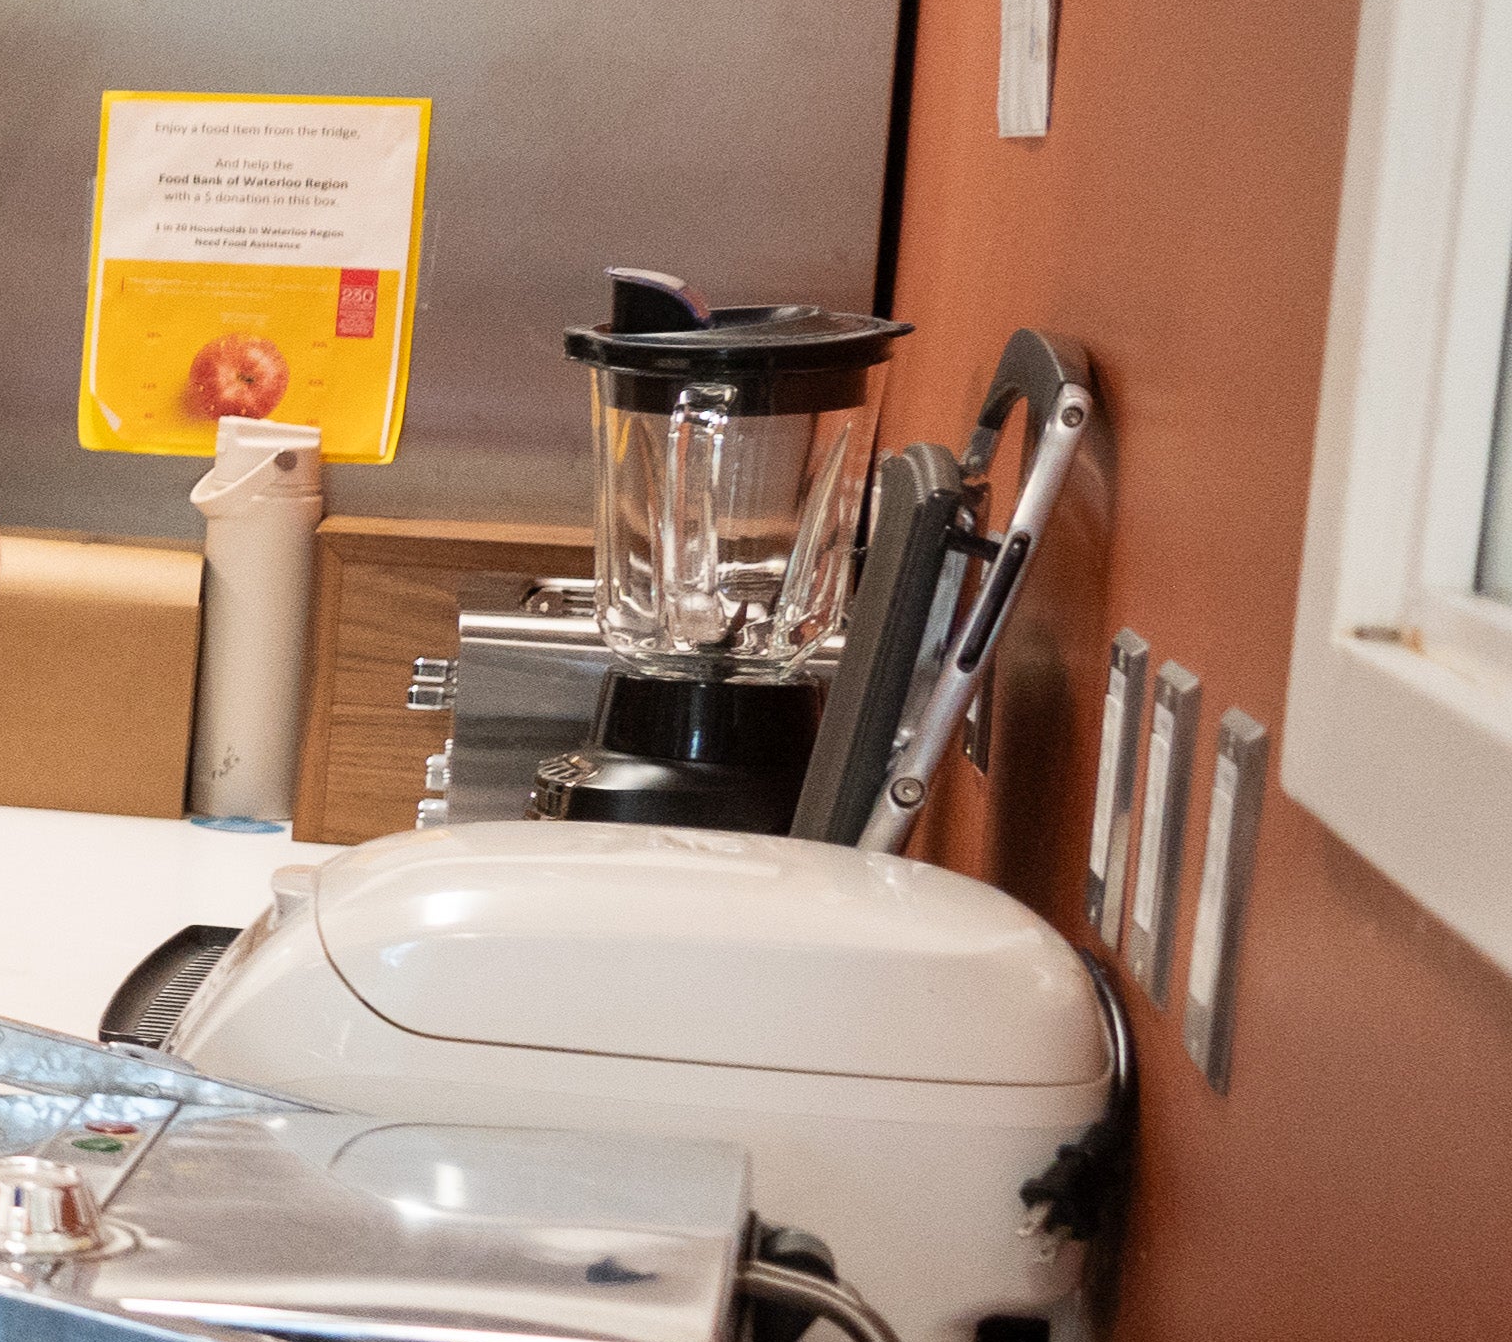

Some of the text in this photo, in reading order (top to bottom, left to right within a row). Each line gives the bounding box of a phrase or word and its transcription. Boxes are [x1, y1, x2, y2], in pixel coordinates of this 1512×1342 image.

[155, 121, 187, 137] Enjoy
[191, 125, 198, 134] a
[201, 122, 230, 134] food
[233, 124, 261, 135] item
[264, 124, 293, 136] from
[297, 126, 318, 136] the
[214, 158, 294, 172] And help the
[158, 173, 349, 192] Food Bank of Waterloo Region
[164, 190, 191, 202] with
[194, 194, 201, 202] a
[215, 192, 271, 205] donation
[273, 194, 285, 205] in
[288, 195, 311, 206] this
[189, 224, 246, 235] Households
[261, 227, 308, 237] Waterloo
[310, 229, 345, 239] Region
[249, 240, 301, 250] Assistance
